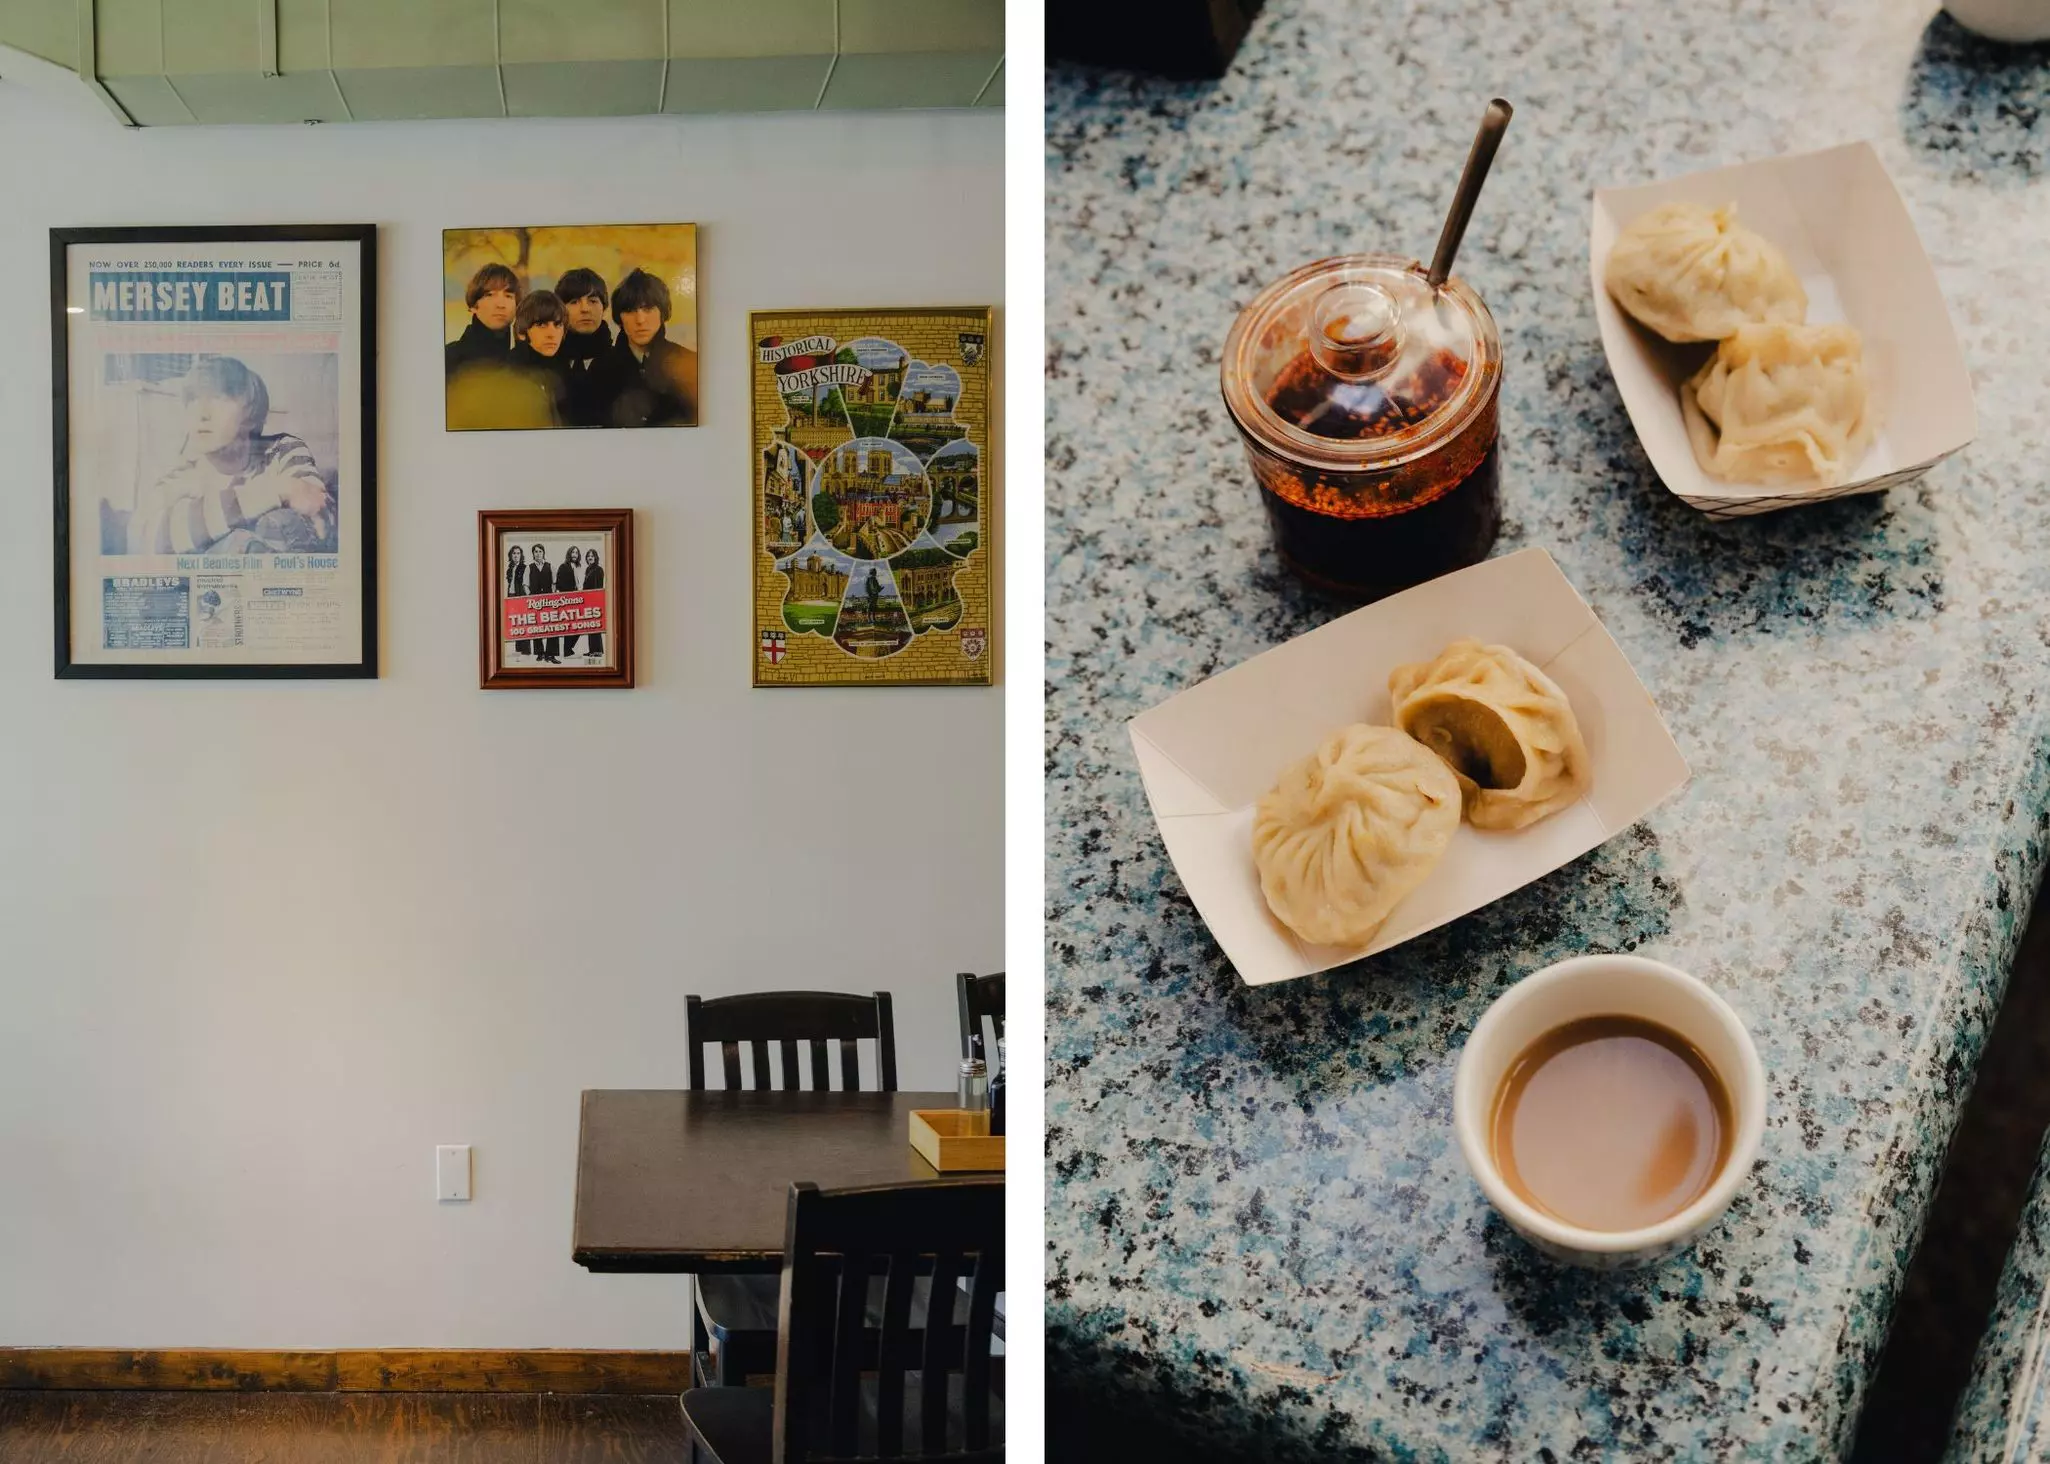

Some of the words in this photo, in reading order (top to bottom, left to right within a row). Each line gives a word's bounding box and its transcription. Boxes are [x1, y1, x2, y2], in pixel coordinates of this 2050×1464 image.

[298, 260, 323, 268] PRICE
[94, 281, 208, 312] MERSEY
[217, 281, 286, 312] BEAT
[762, 338, 832, 361] HISTORICAL
[777, 365, 866, 392] YORKSHIRE
[176, 557, 200, 570] Next
[202, 557, 241, 570] Beatles
[242, 556, 263, 570] Film
[307, 555, 339, 569] House
[508, 613, 537, 626] THE
[540, 607, 602, 623] BEATLES
[510, 627, 526, 636] 100
[527, 623, 570, 635] GREATEST
[571, 620, 601, 630] SONGS
